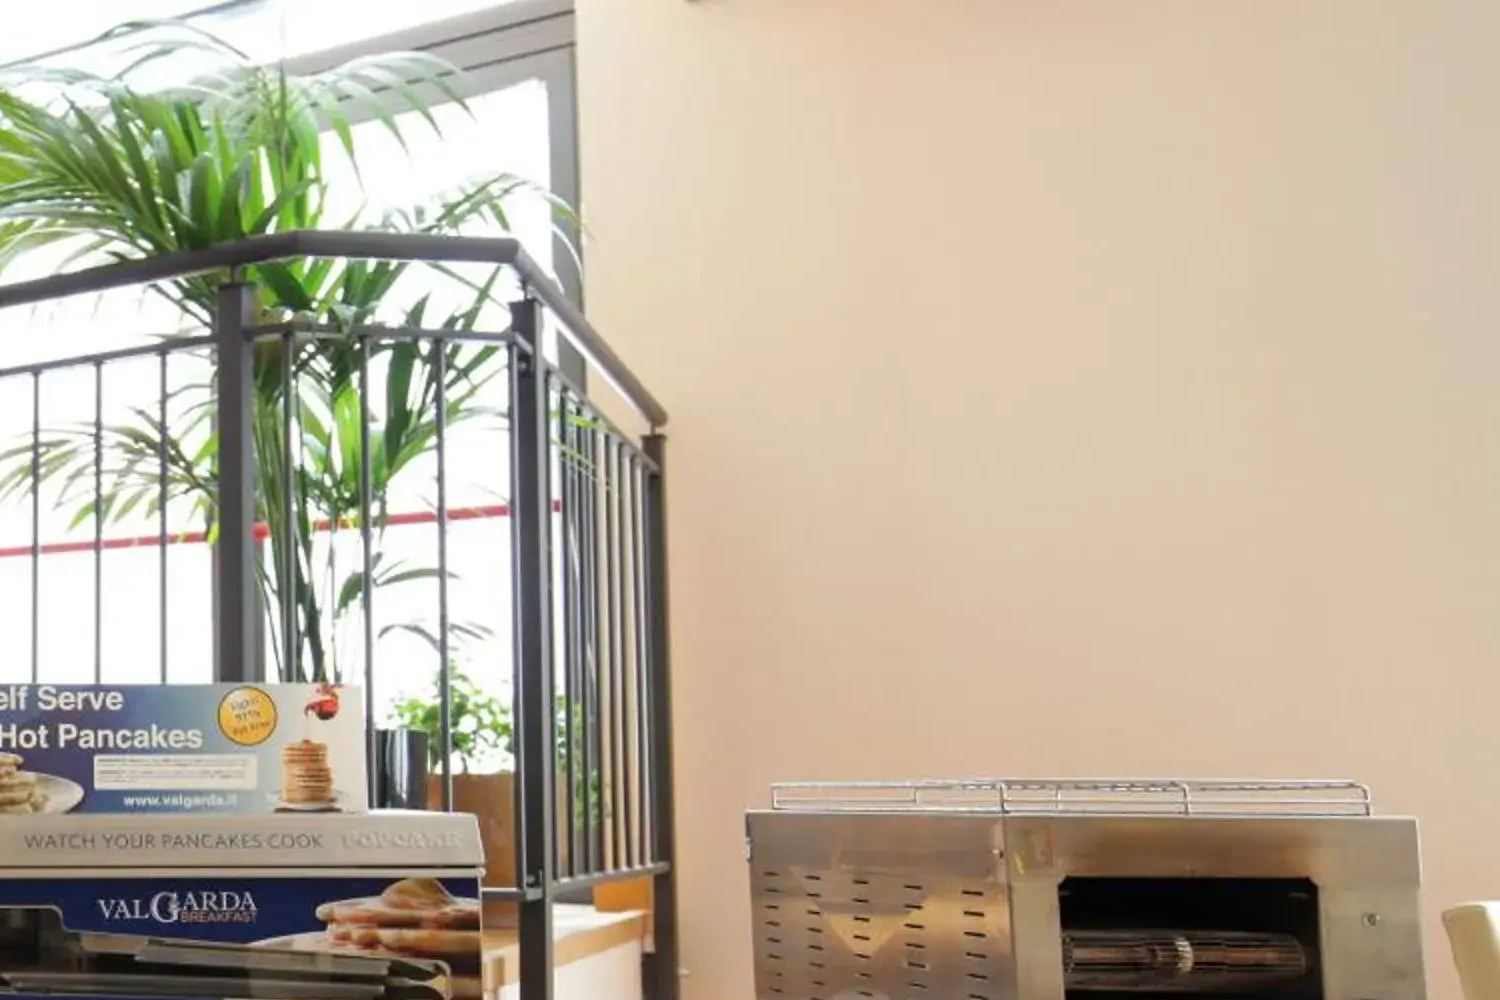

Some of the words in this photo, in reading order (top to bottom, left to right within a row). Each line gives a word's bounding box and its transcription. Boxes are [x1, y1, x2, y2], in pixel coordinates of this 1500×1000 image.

[37, 685, 124, 711] Serve
[58, 723, 204, 750] Pancakes
[123, 794, 238, 809] www.valgarda.it
[24, 833, 96, 849] WATCH
[102, 833, 156, 849] YOUR
[162, 833, 262, 849] PANCAKES
[268, 833, 324, 849] COOK
[180, 909, 258, 924] BREAKFAST
